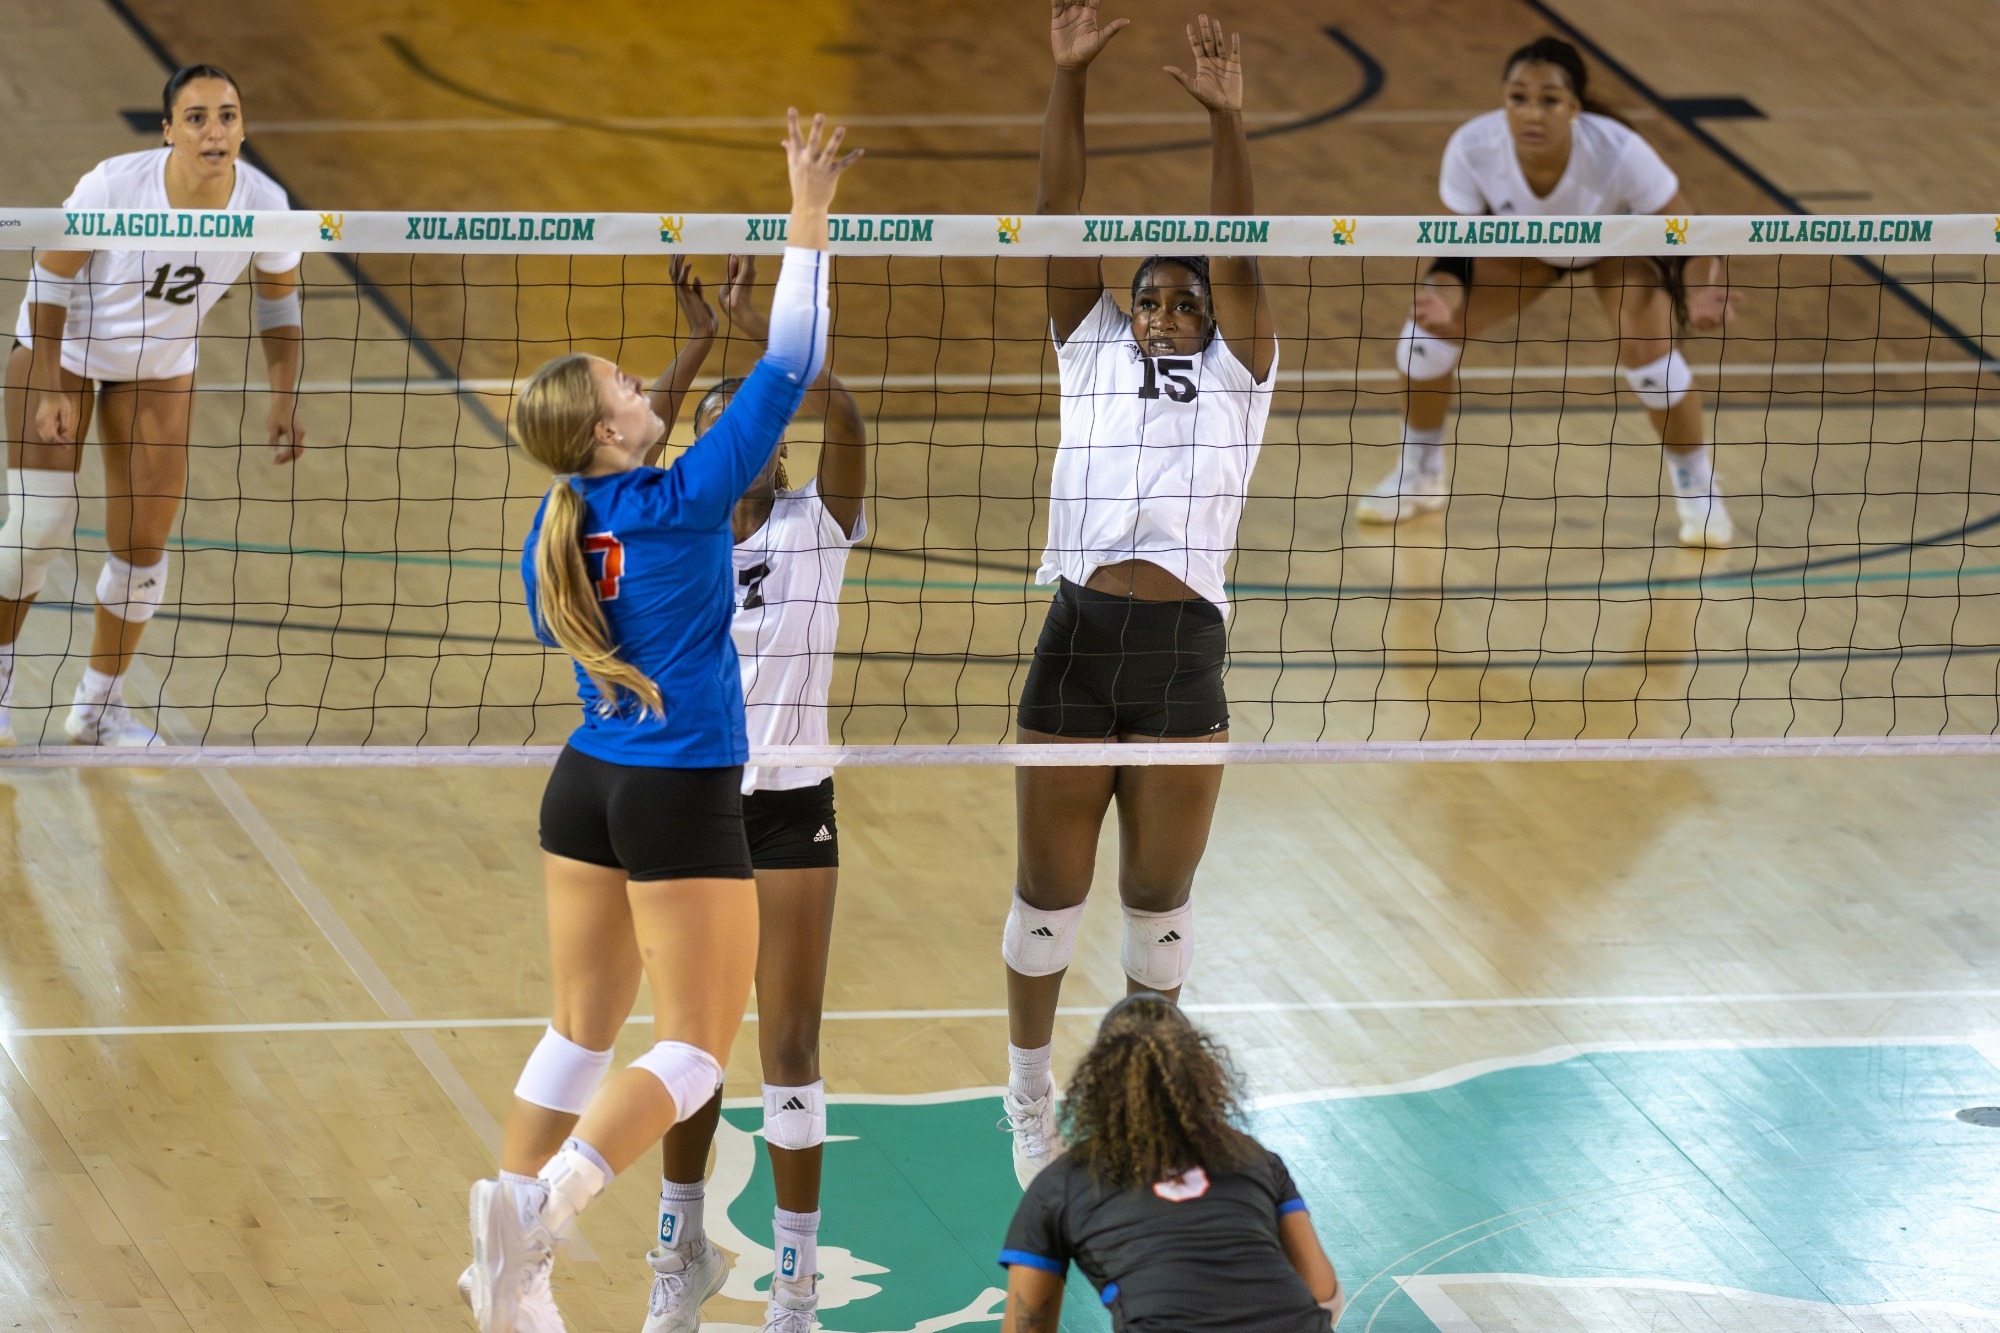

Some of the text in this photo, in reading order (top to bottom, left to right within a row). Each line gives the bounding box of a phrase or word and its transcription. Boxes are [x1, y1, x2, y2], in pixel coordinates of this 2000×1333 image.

[64, 213, 254, 238] XULAGOLD.COM
[405, 217, 595, 241] XULAGOLD.COM
[745, 218, 934, 242] XULOLD.COM
[1083, 219, 1269, 243] XULAGOLD.COM
[1417, 221, 1602, 245] XULAGOLD.COM
[1748, 220, 1933, 243] XULAGOLD.COM
[144, 263, 205, 306] 12
[1137, 357, 1198, 404] 15
